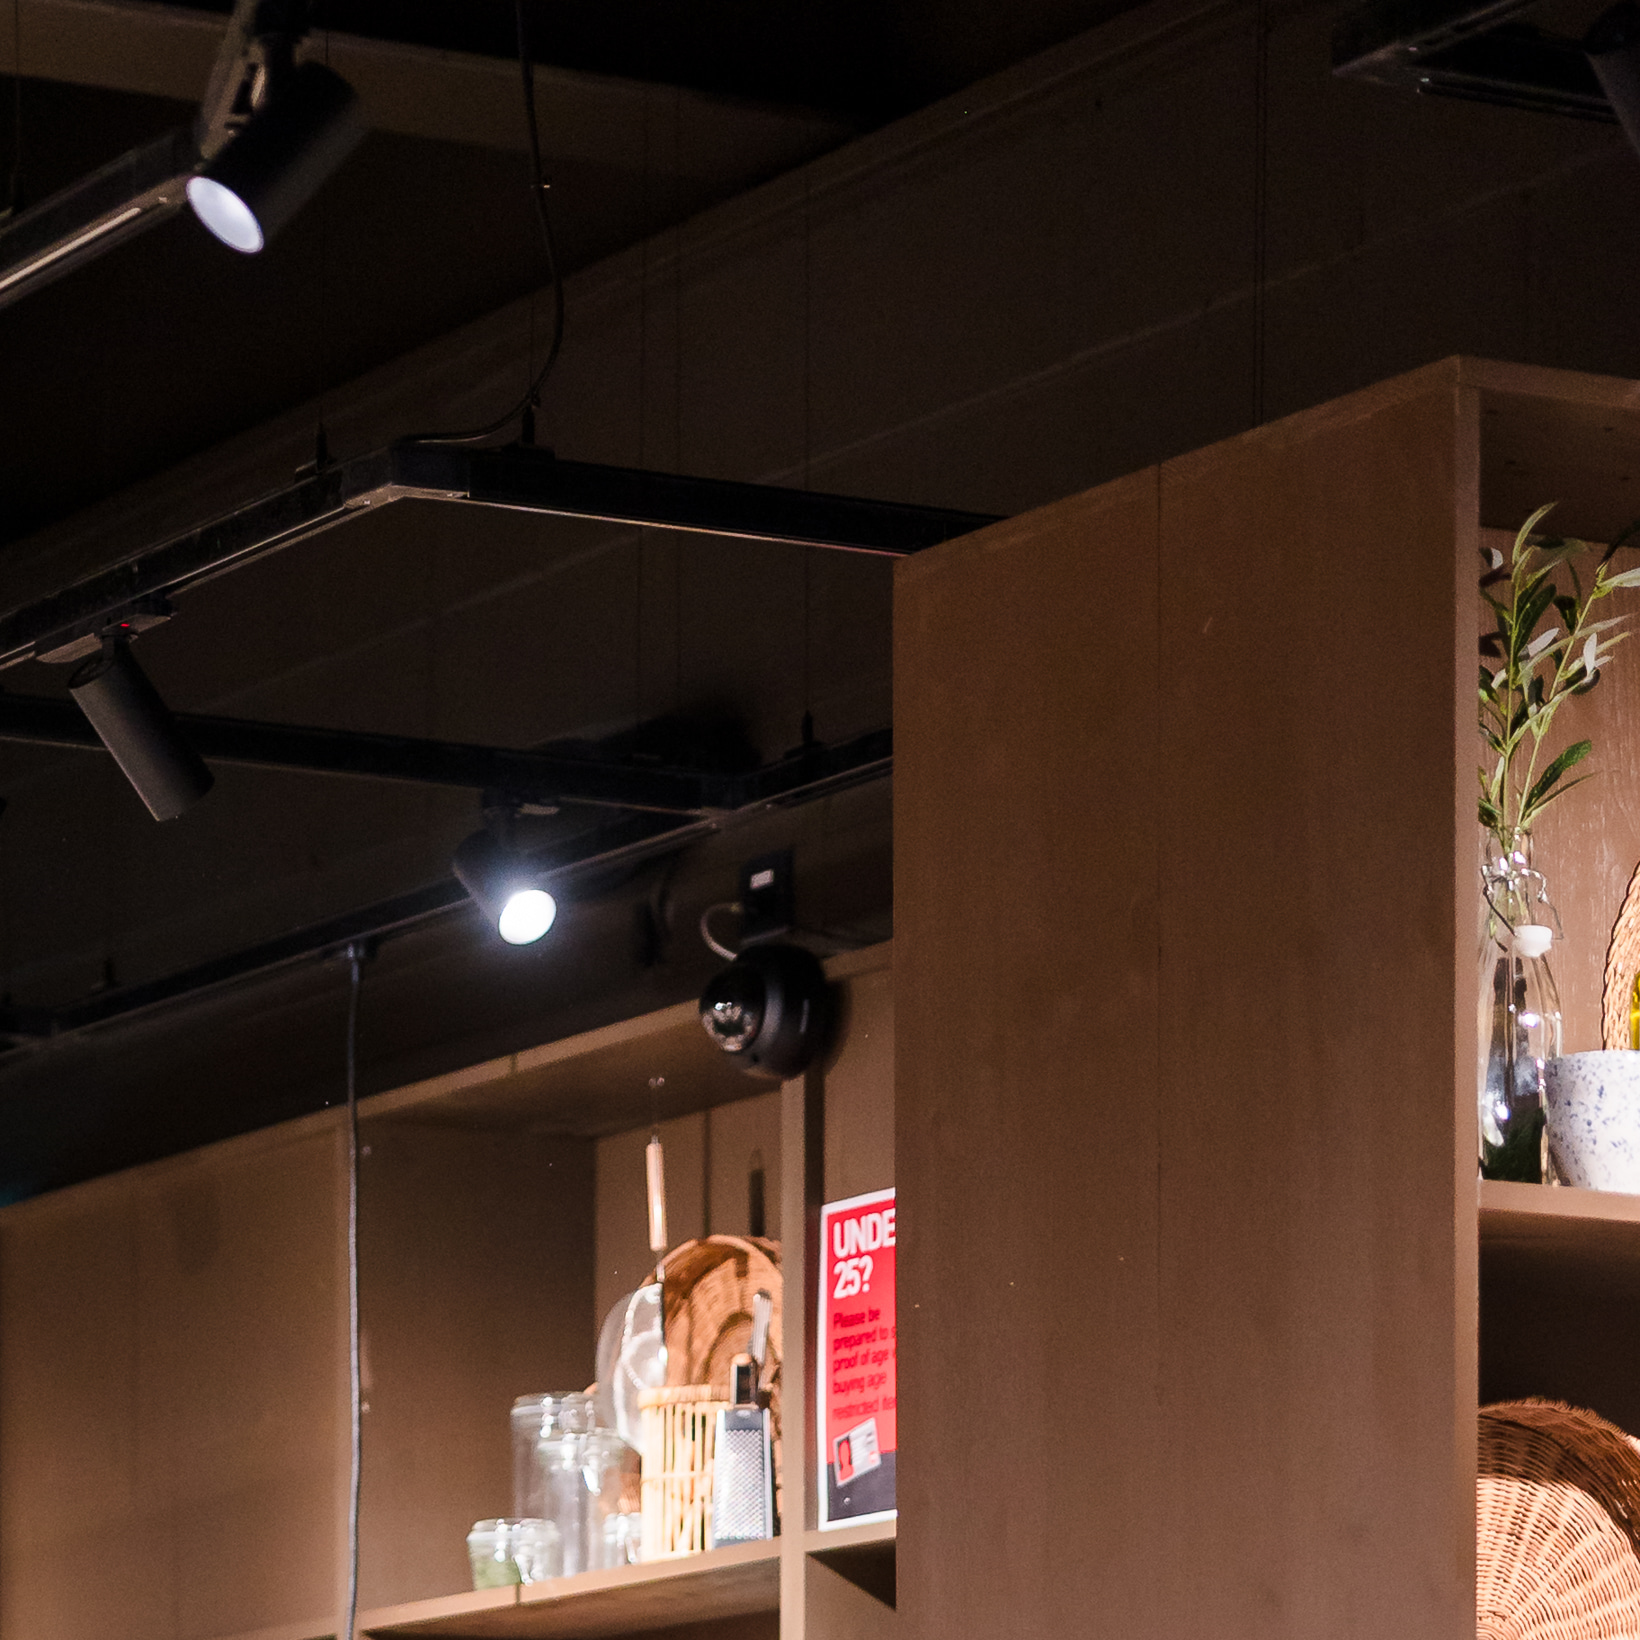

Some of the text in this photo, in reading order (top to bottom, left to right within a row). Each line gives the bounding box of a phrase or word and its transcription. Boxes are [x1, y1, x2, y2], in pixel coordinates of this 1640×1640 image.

[833, 1254, 874, 1299] 25?
[833, 1306, 880, 1329] Please be
[833, 1326, 877, 1355] prepared
[879, 1326, 889, 1341] to
[833, 1347, 889, 1376] proof of age
[833, 1371, 887, 1397] buying age
